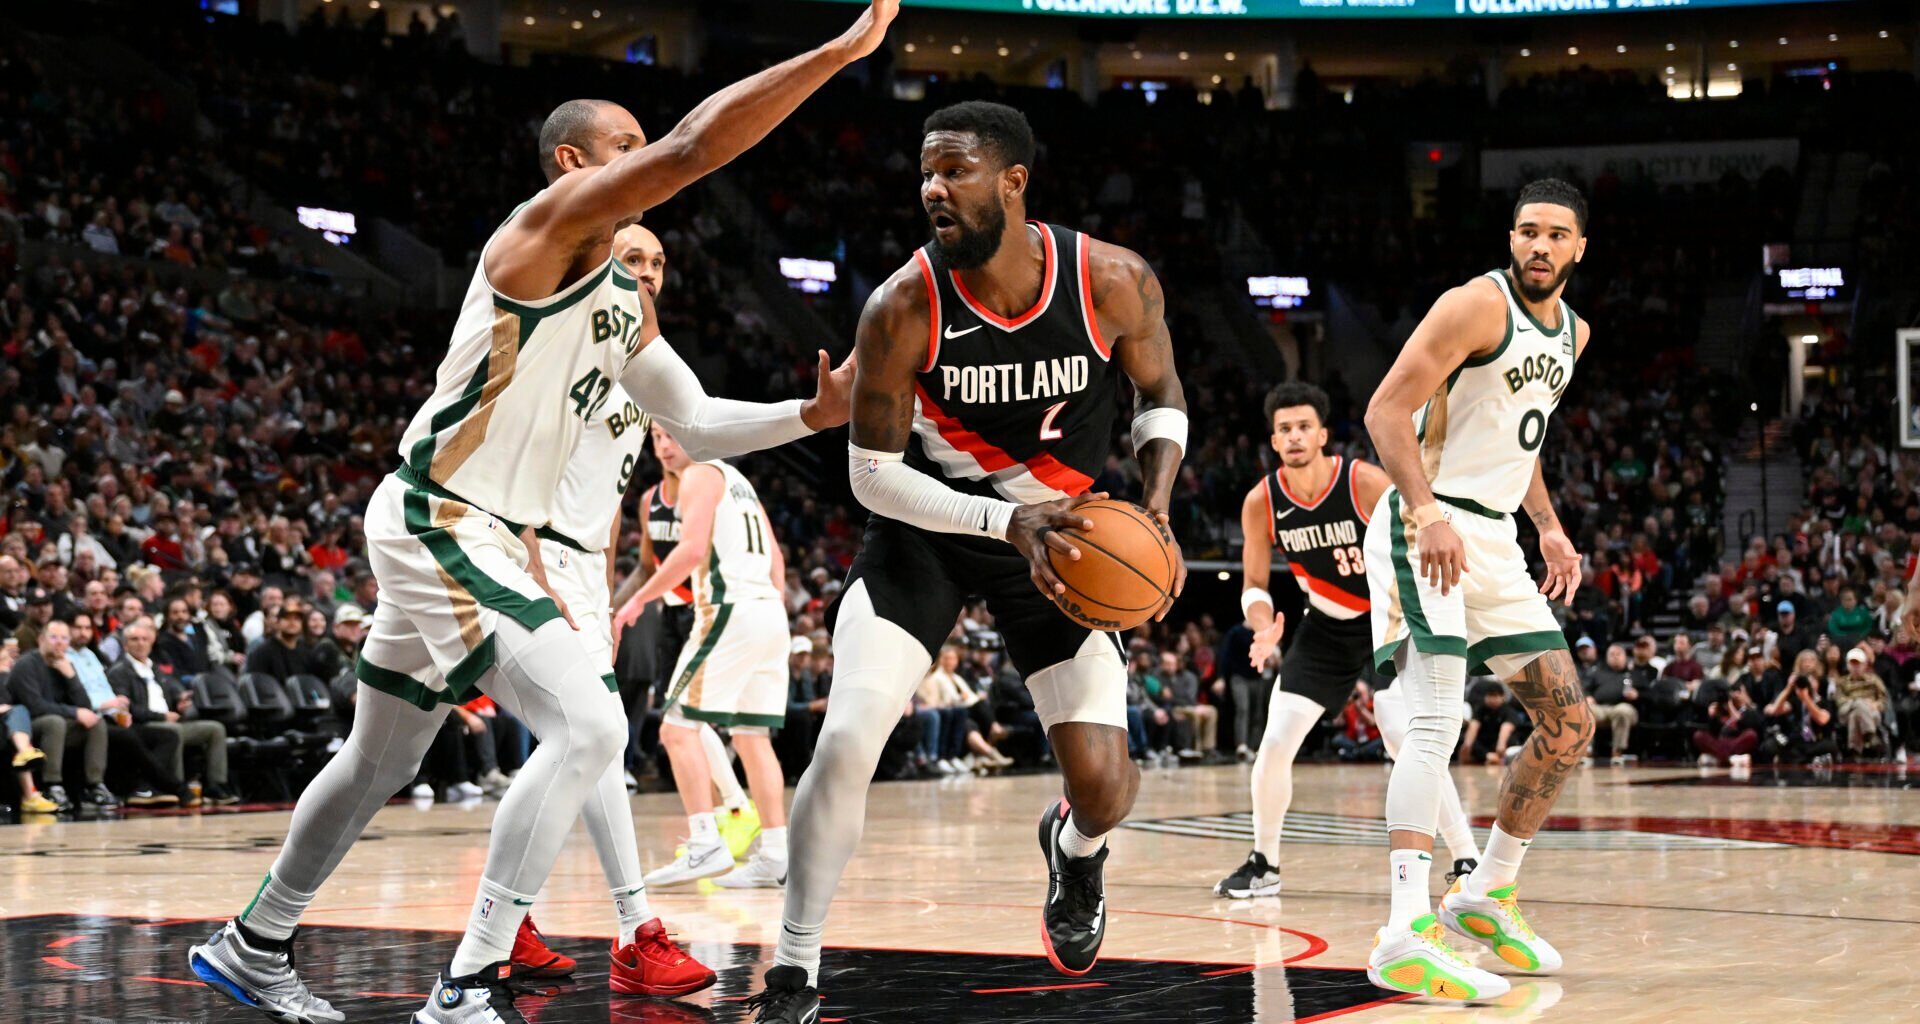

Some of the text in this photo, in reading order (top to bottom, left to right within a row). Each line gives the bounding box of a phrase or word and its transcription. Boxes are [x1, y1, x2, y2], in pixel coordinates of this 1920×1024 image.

[569, 366, 611, 427] 42
[940, 355, 1089, 404] PORTLAND
[1040, 401, 1068, 440] 2
[1518, 409, 1545, 451] 0
[617, 453, 634, 495] 9
[743, 511, 766, 555] 11
[1278, 519, 1358, 553] PORTLAND
[1333, 546, 1366, 577] 33
